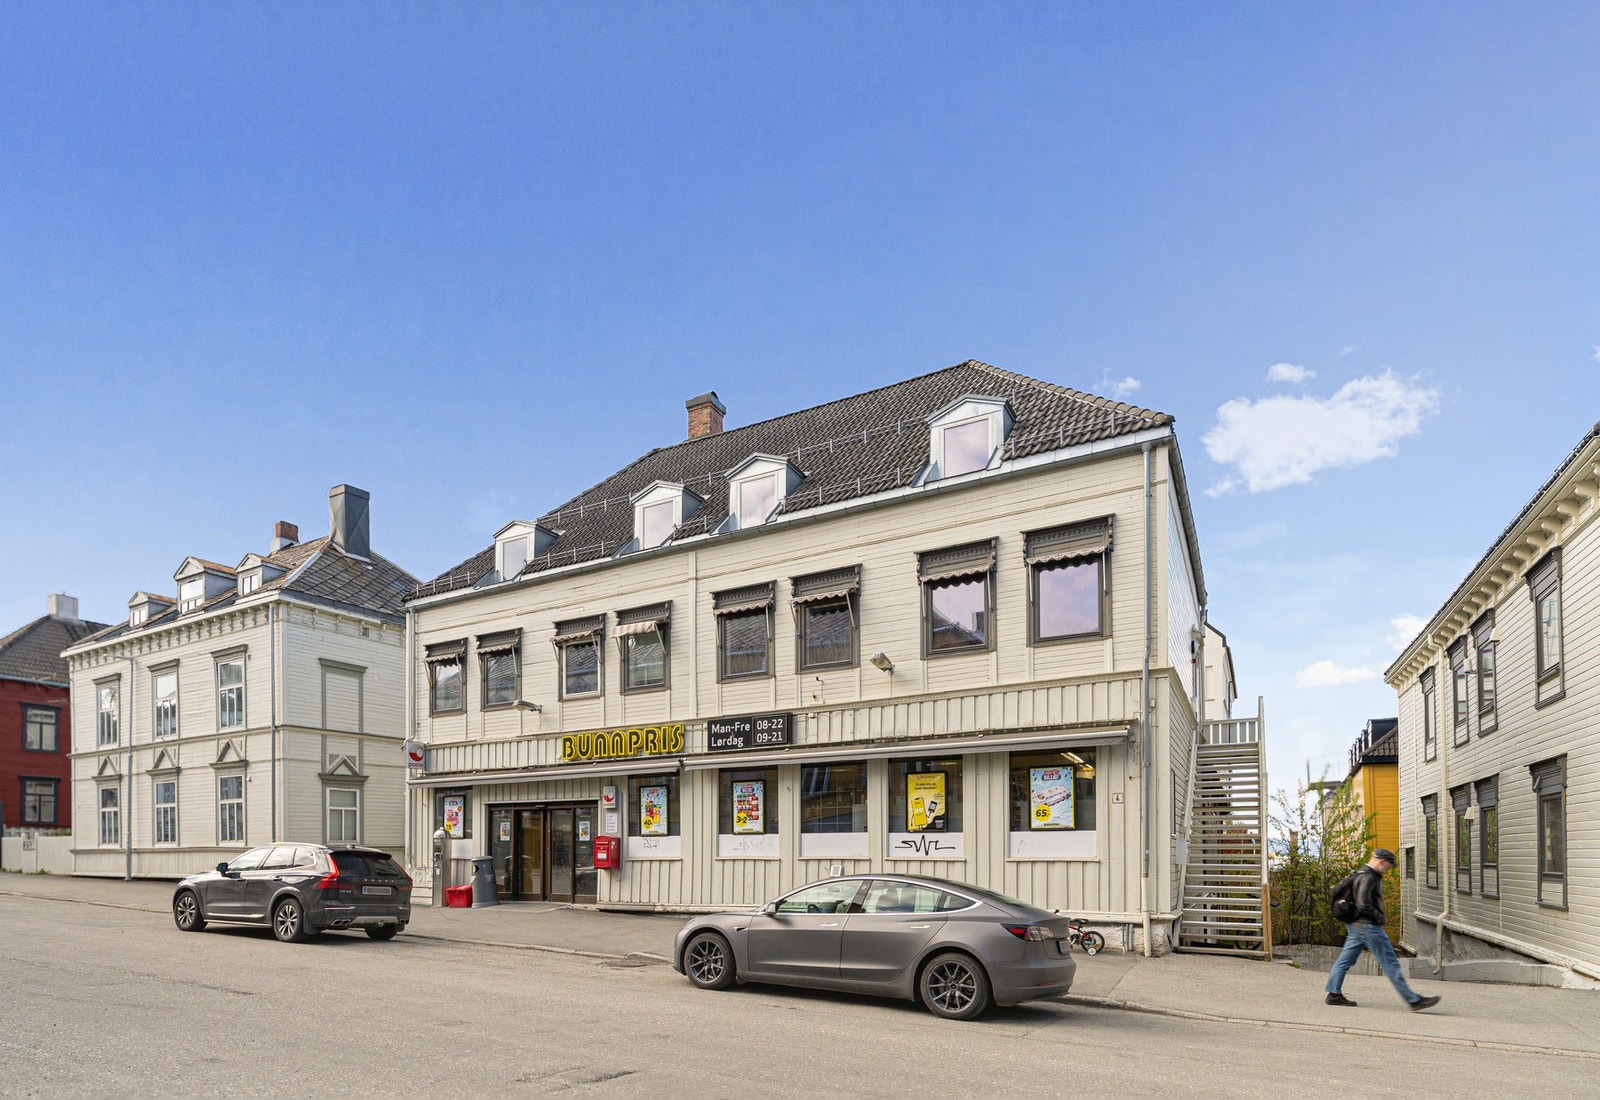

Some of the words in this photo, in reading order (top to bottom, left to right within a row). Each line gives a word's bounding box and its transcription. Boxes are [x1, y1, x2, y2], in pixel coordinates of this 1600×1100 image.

[711, 721, 750, 735] Man-Fre
[756, 718, 783, 731] 08-22
[561, 724, 684, 761] BUNNPRIS
[711, 735, 744, 748] Lørdag
[756, 731, 783, 744] 09-21
